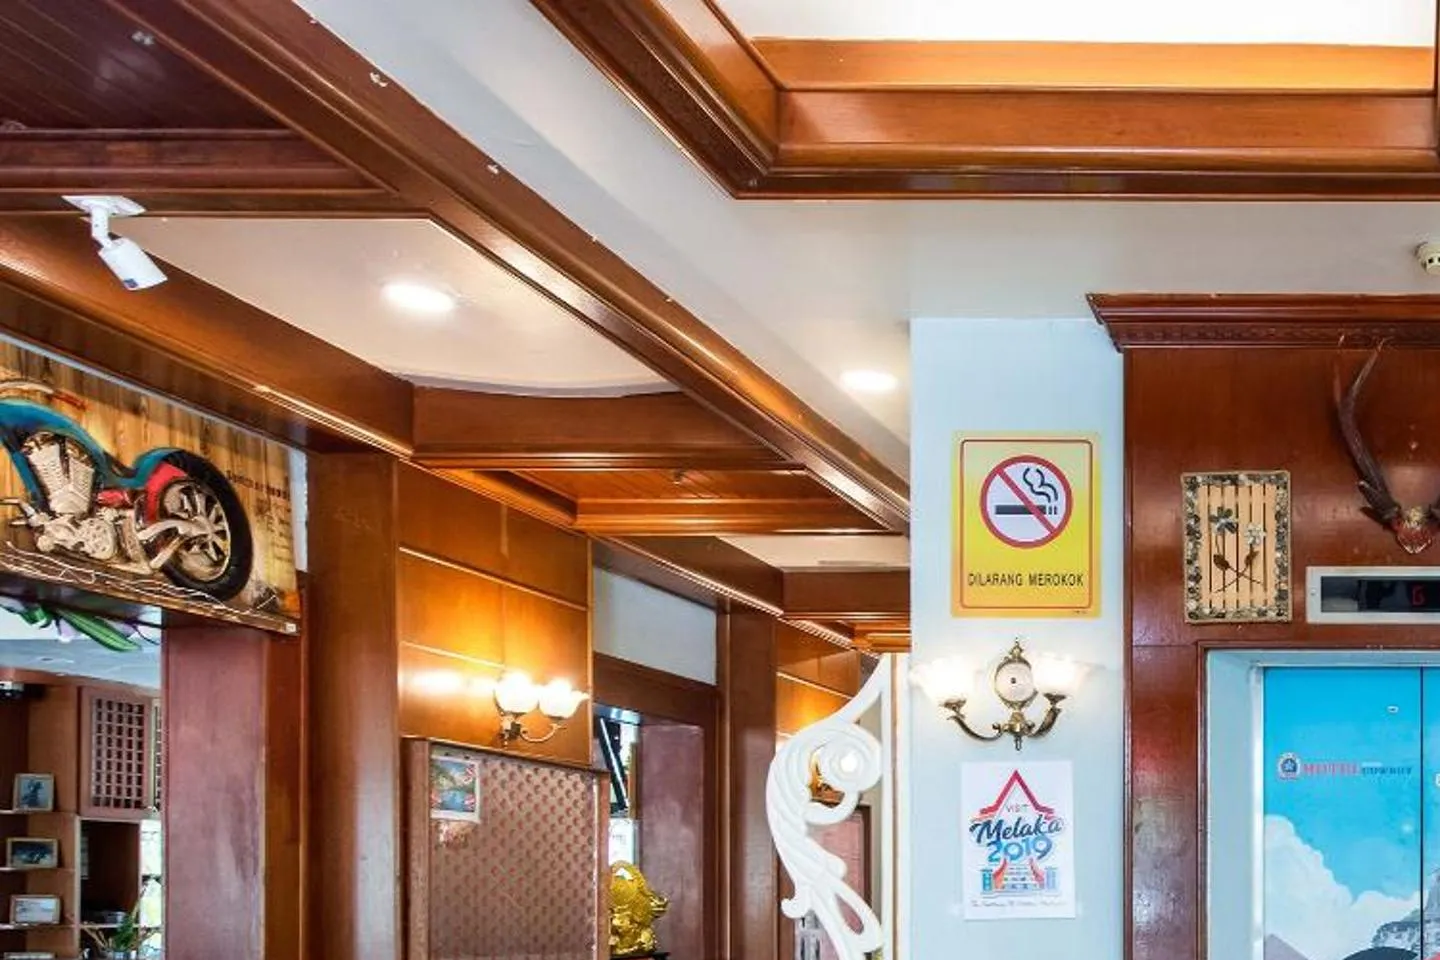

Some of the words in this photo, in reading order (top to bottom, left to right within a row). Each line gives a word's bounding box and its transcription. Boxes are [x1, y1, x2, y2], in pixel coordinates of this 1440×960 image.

[967, 573, 1023, 587] DILARANG
[1028, 573, 1084, 587] MEROKOK
[1006, 803, 1030, 814] VISIT
[969, 813, 1063, 844] Melaka
[986, 835, 1053, 863] 2019
